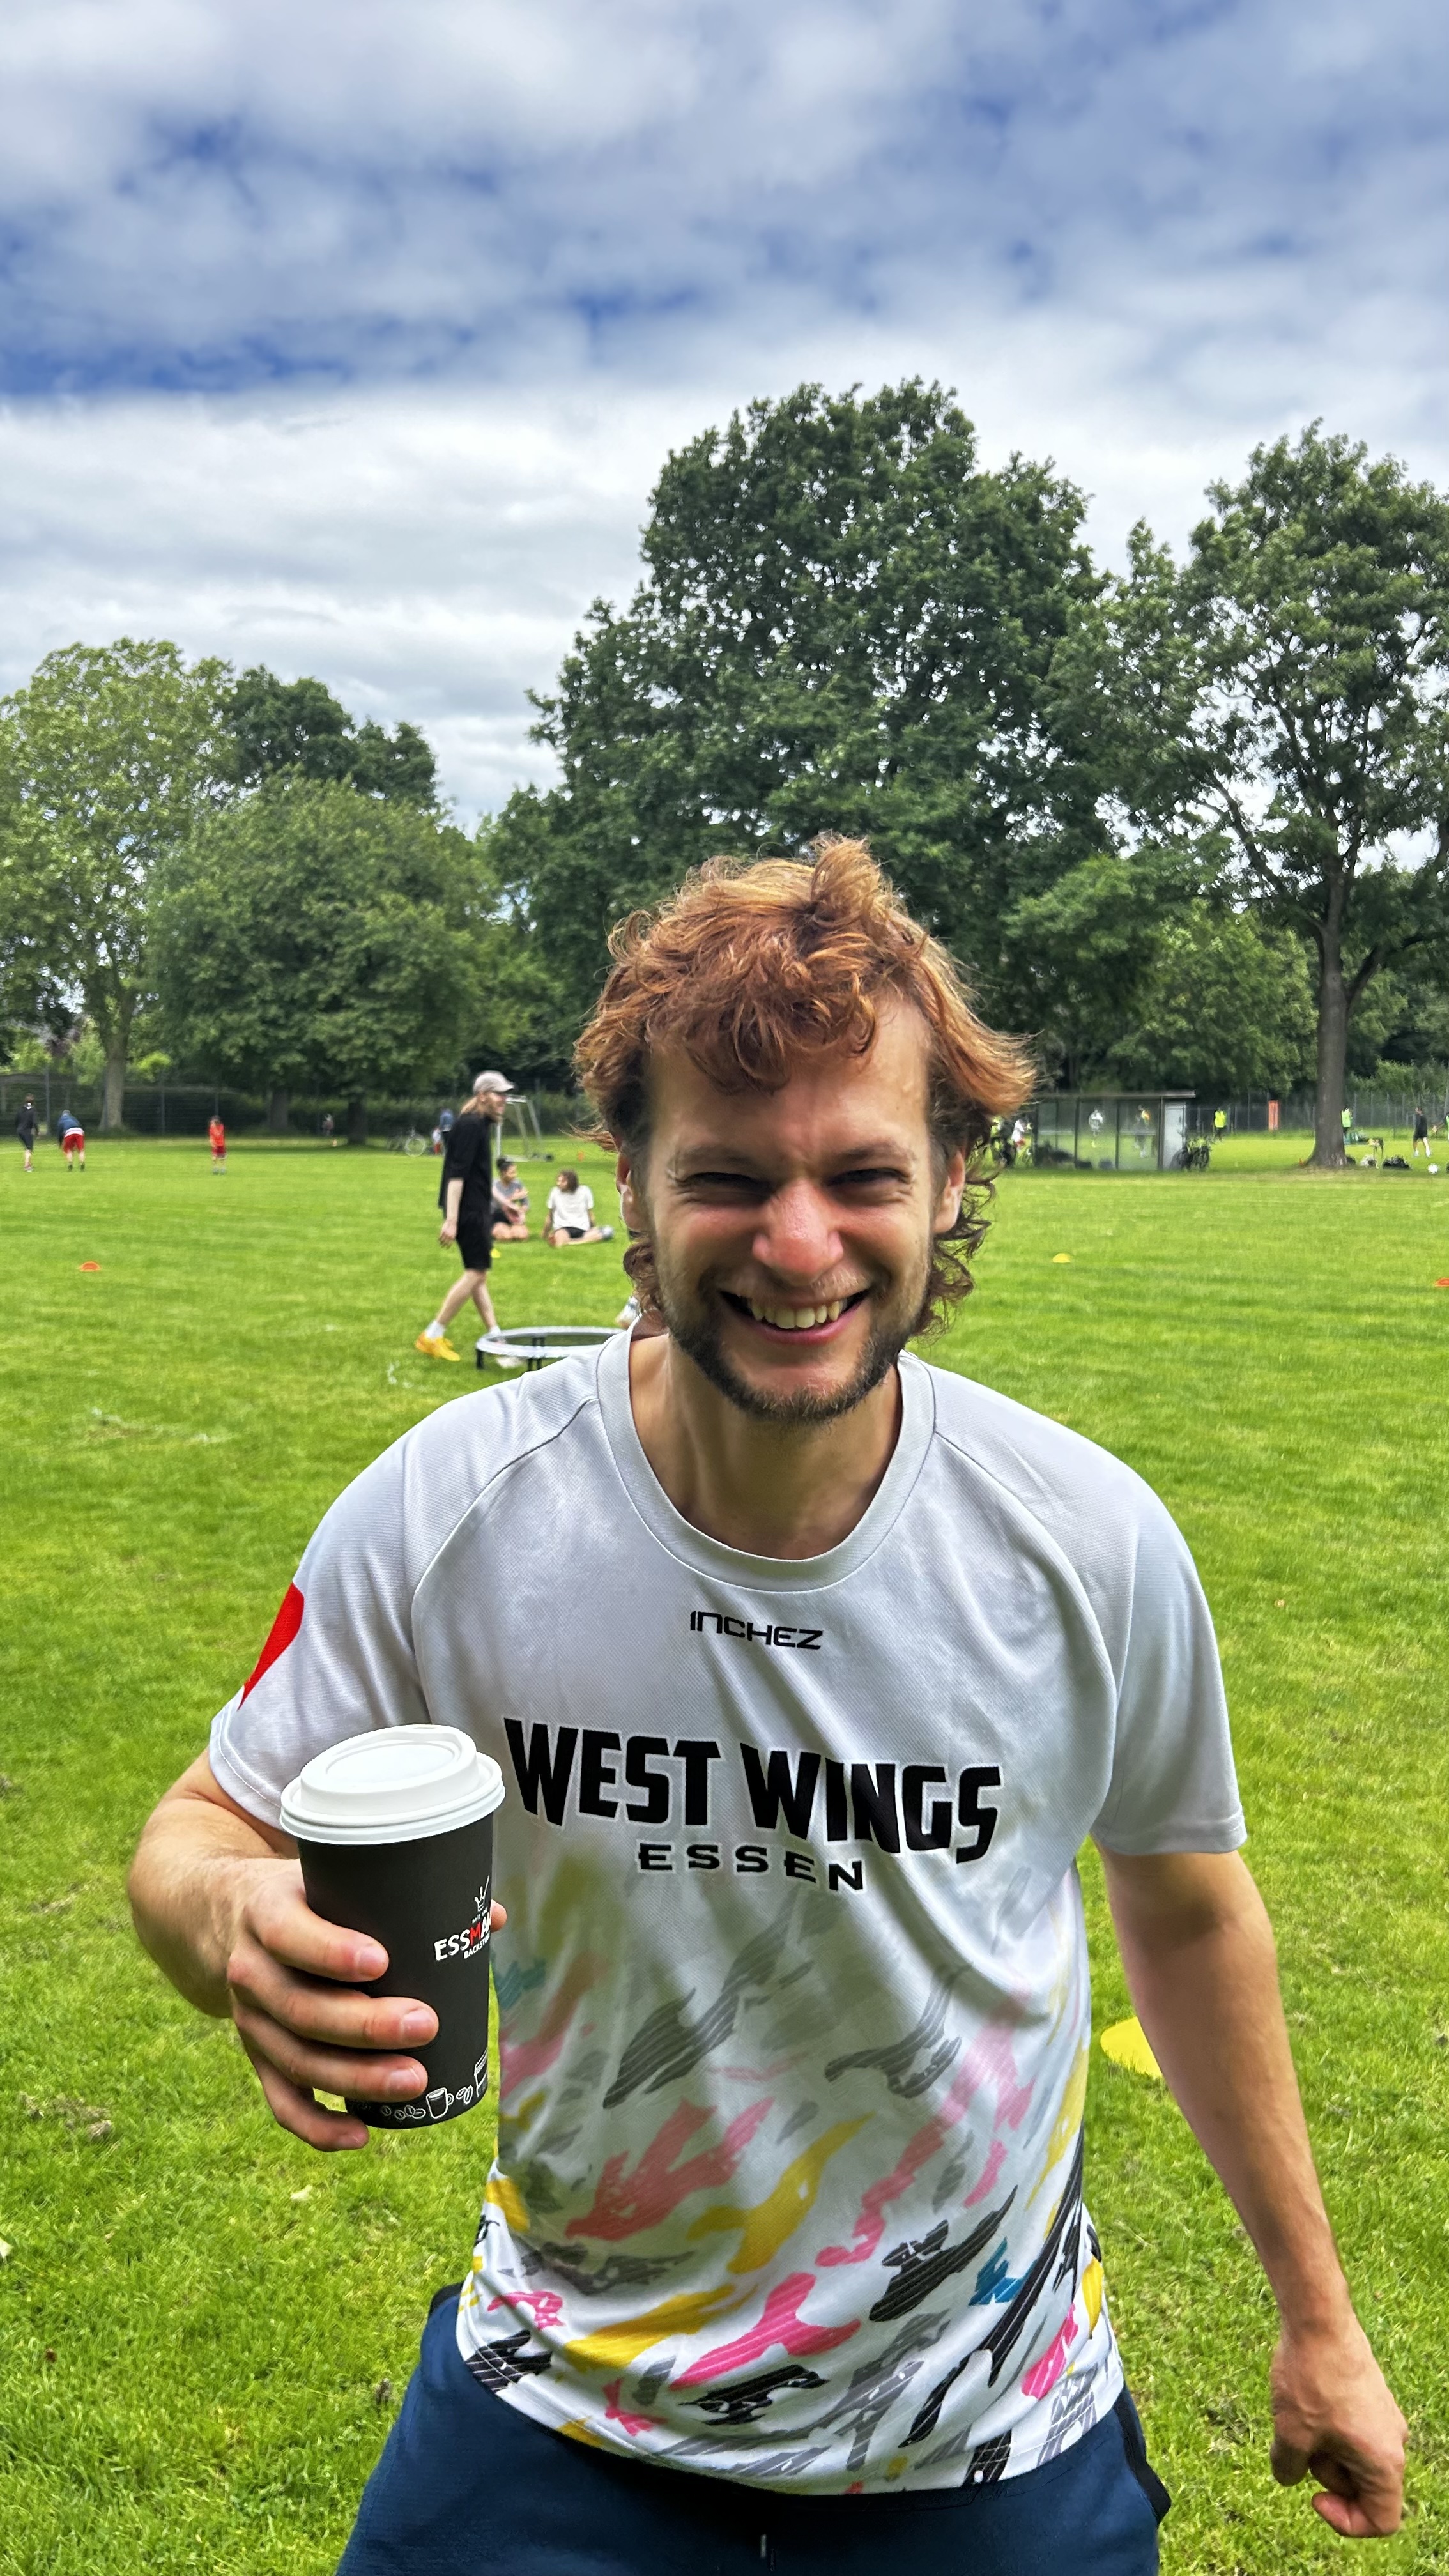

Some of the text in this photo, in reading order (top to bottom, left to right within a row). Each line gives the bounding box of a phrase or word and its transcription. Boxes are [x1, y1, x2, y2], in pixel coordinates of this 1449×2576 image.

[689, 1610, 824, 1651] INCHEZ
[503, 1717, 1002, 1864] WEST WINGS
[638, 1842, 864, 1892] ESSEN
